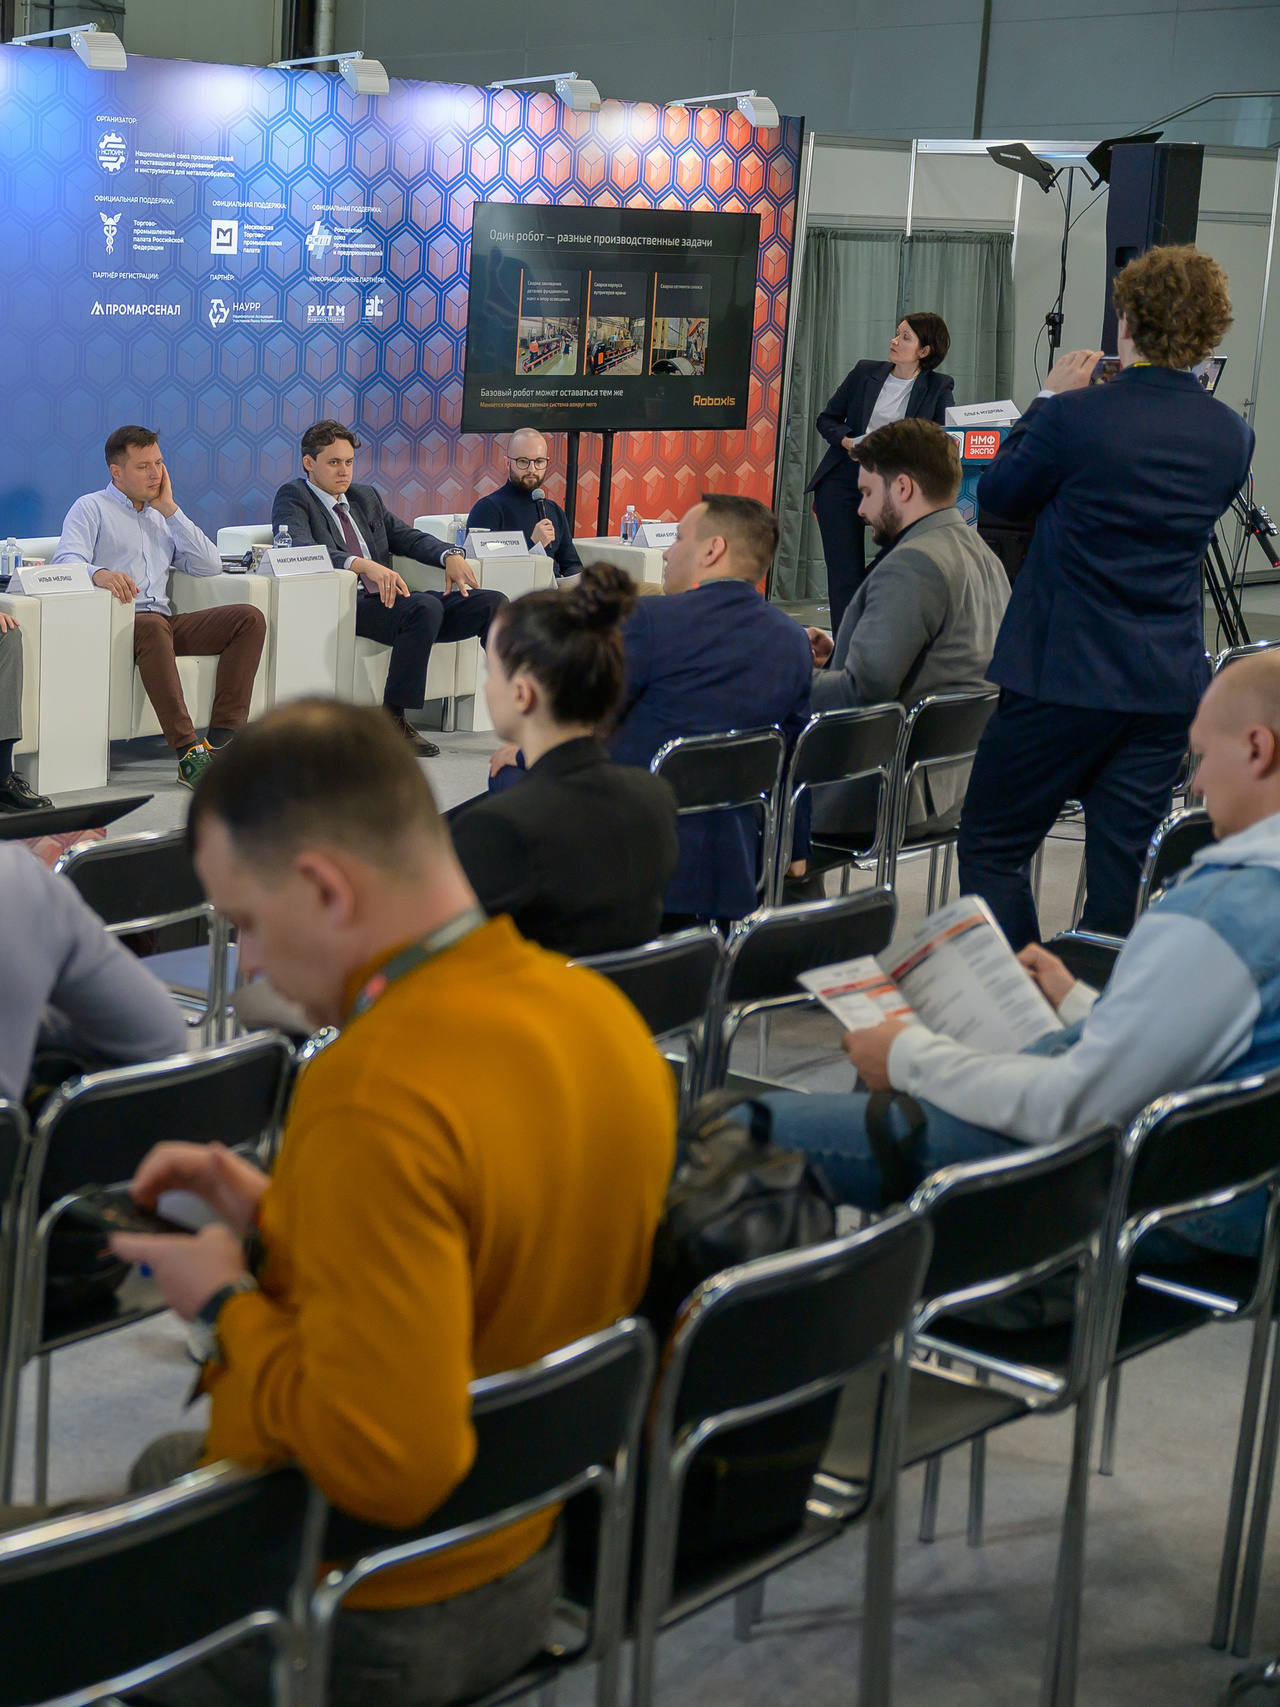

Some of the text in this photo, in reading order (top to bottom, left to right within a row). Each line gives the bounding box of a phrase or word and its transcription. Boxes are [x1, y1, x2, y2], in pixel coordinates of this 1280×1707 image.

[96, 115, 138, 125] ОРГАНИЗАТОР:
[94, 195, 175, 205] ОФИЦИАЛЬНАЯ ПОДДЕРЖКА:
[212, 200, 287, 210] ОФИЦИАЛЬНАЯ ПОДДЕРЖКА:
[312, 204, 350, 212] ОФИЦИАЛЬНАЯ
[489, 228, 515, 241] Один
[516, 231, 545, 243] робот
[557, 233, 592, 244] разные
[593, 234, 680, 247] производственные
[681, 237, 713, 248] задачи
[106, 303, 181, 315] ПРОМАРСЕНАЛ
[232, 302, 261, 311] НАУРР
[308, 305, 346, 316] РИТМ
[480, 388, 624, 398] Базовый робот может оставаться тем же
[970, 435, 996, 445] НМФ
